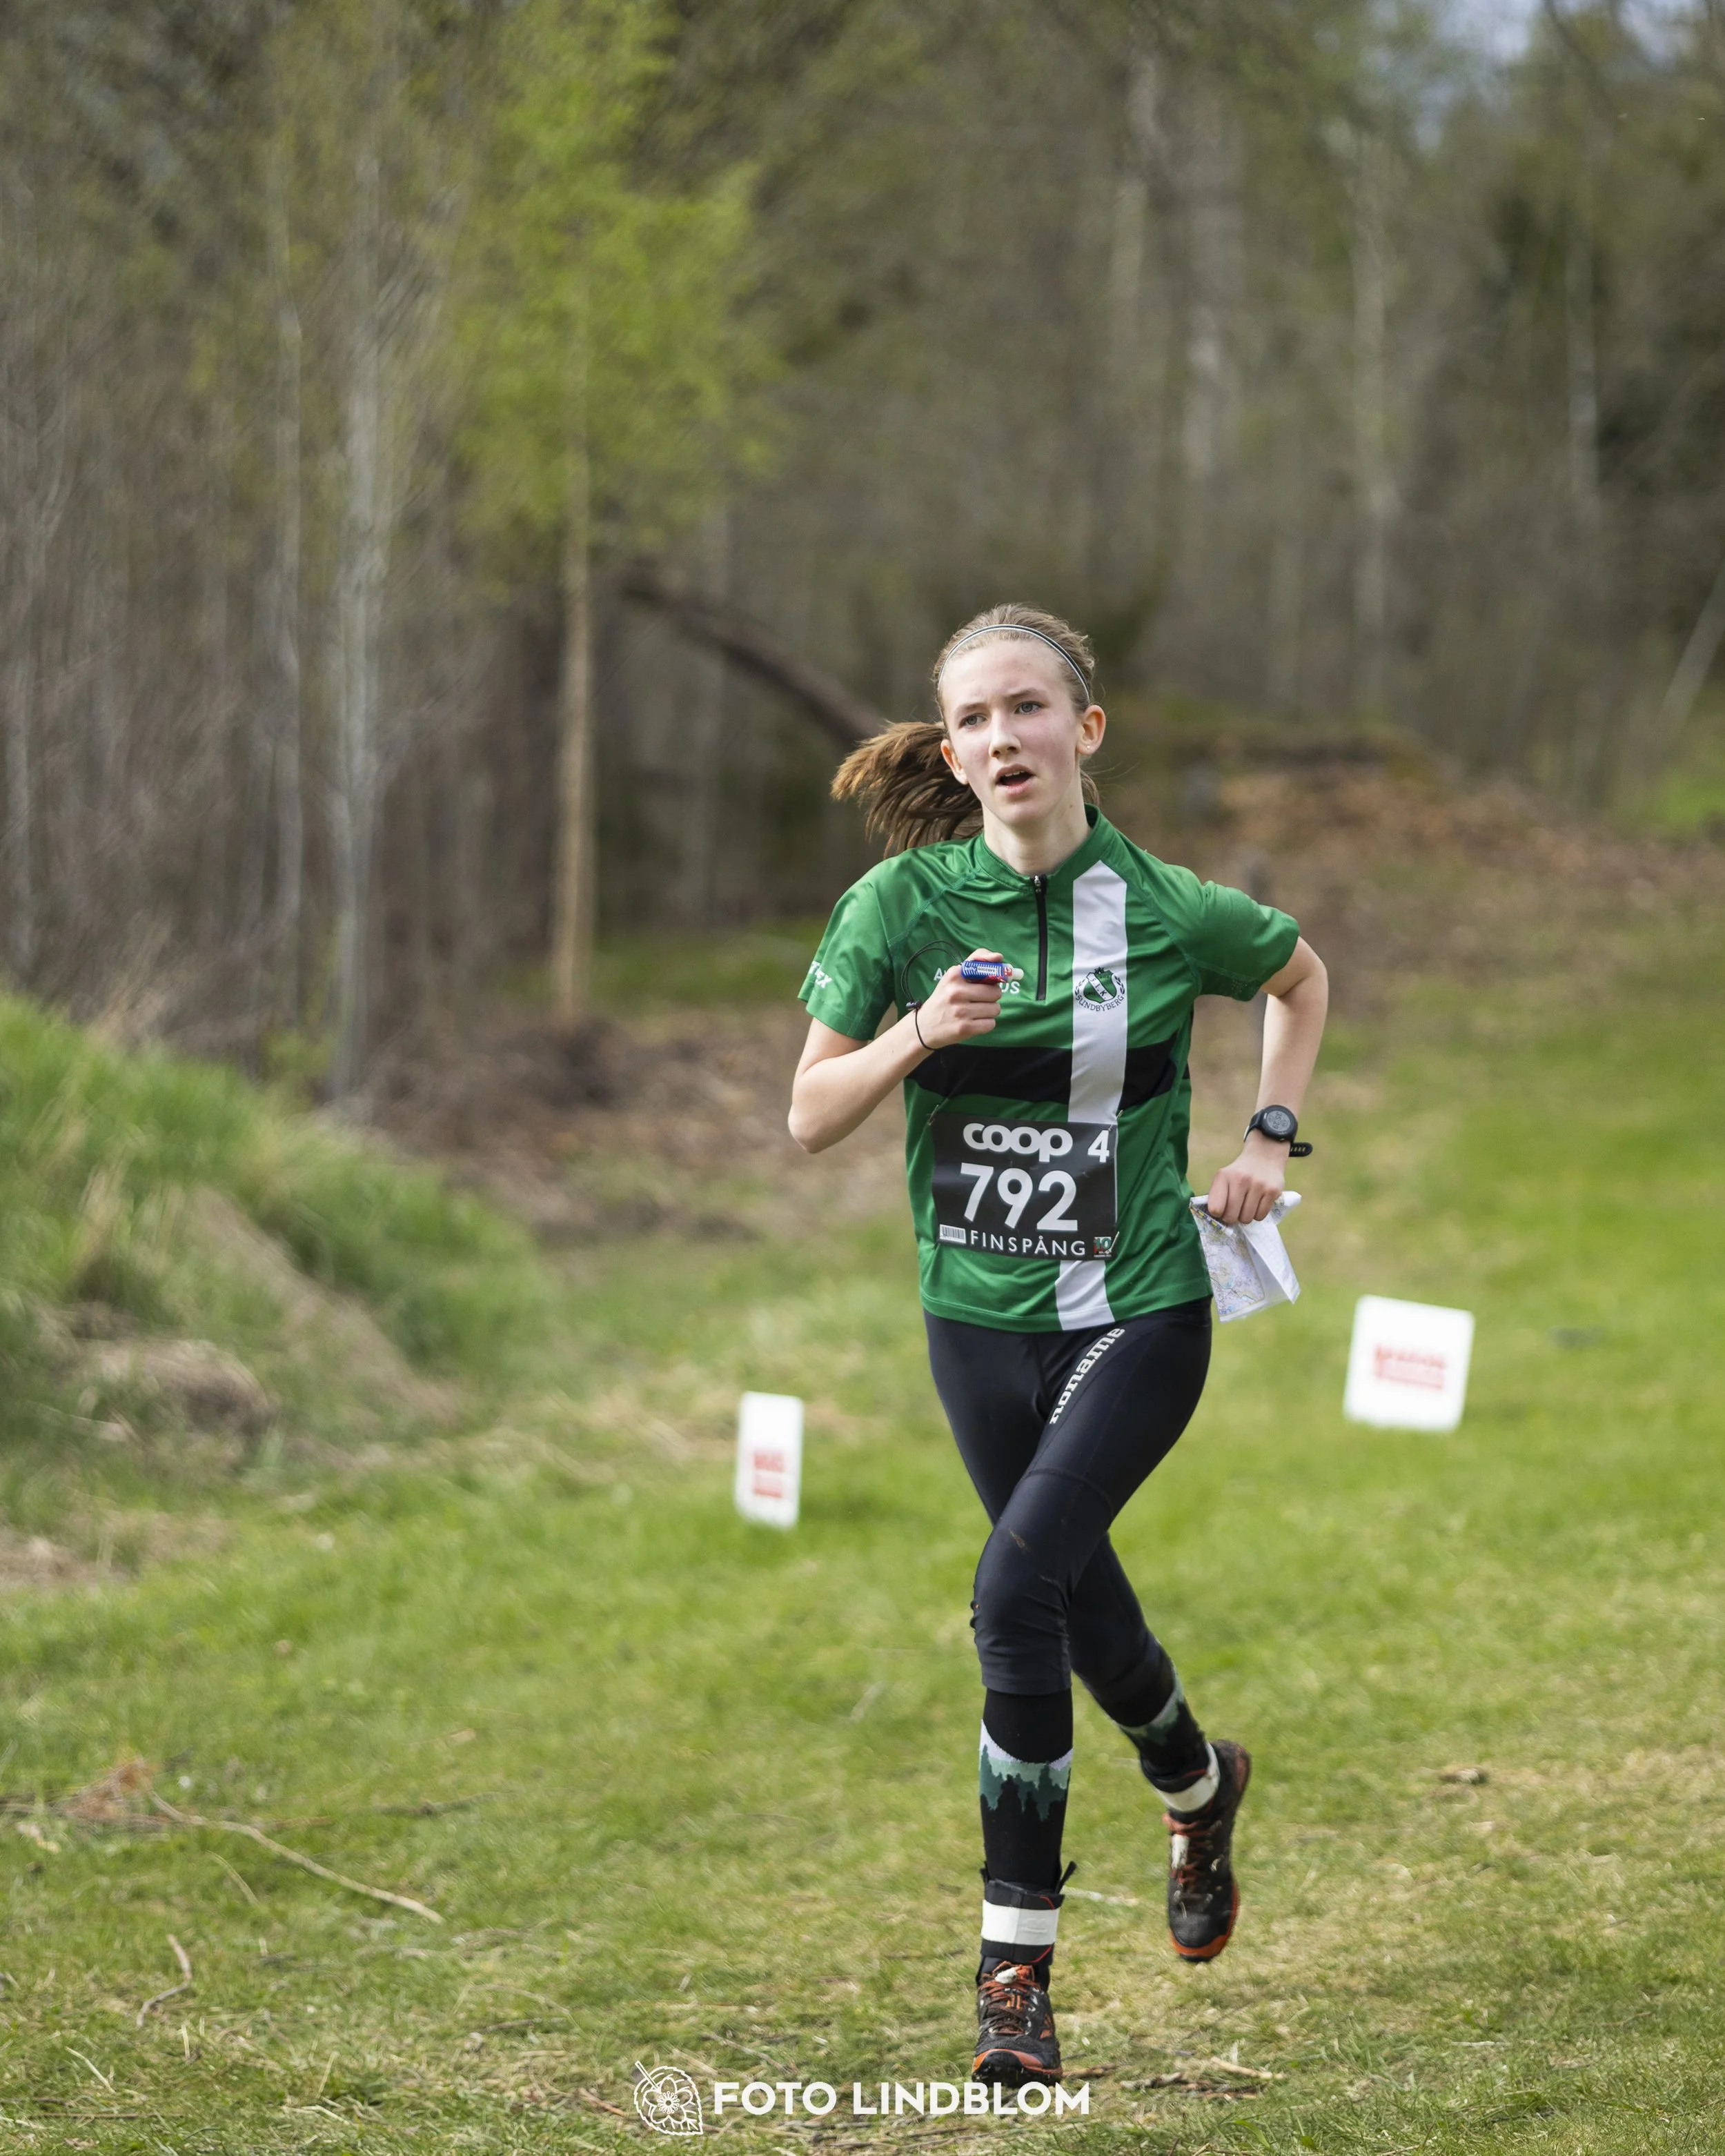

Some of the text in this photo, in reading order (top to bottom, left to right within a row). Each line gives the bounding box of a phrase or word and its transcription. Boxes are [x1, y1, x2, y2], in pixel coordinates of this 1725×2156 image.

[1075, 994, 1124, 1012] SUNDBYBERG
[963, 1122, 1073, 1163] coop
[1087, 1129, 1110, 1163] 4
[960, 1162, 1078, 1232] 792
[970, 1229, 1085, 1256] FINSPÅNG
[1049, 1327, 1125, 1425] noname
